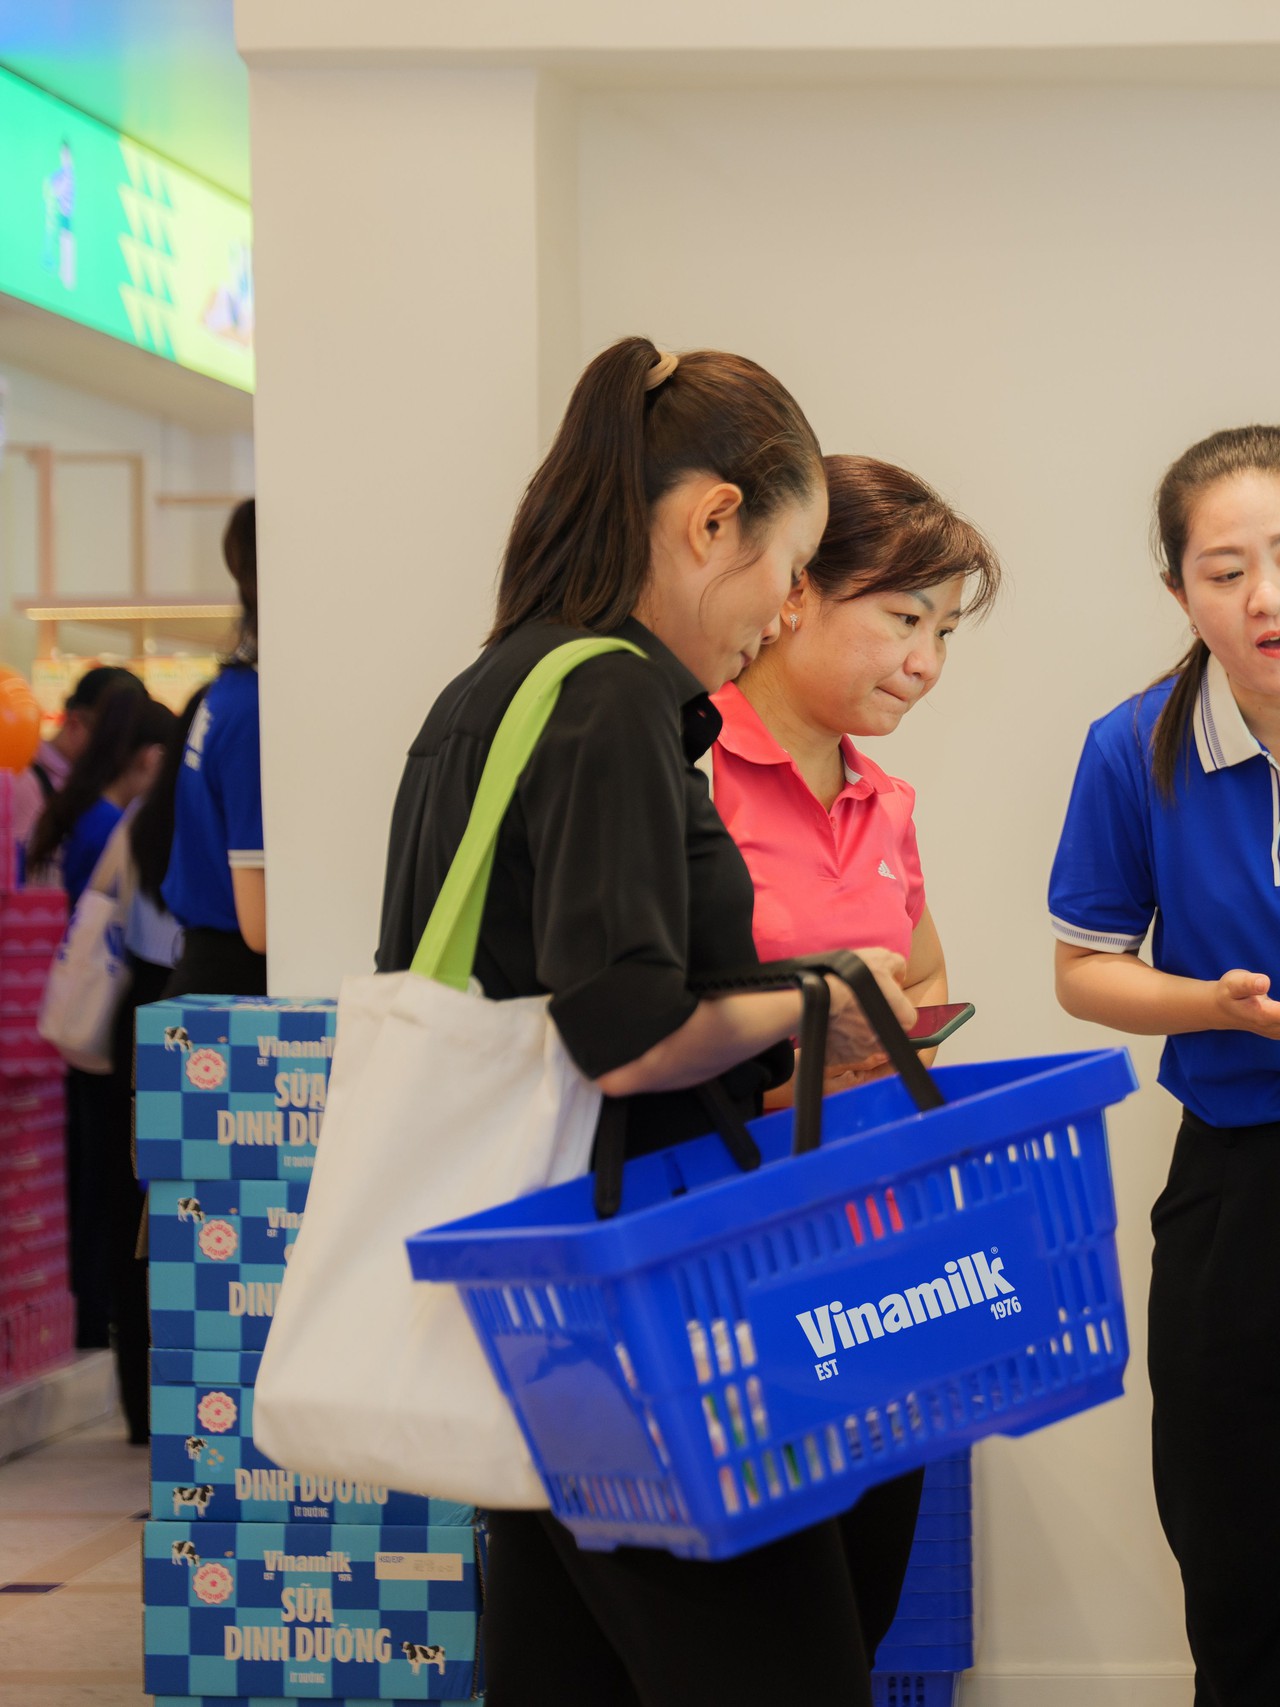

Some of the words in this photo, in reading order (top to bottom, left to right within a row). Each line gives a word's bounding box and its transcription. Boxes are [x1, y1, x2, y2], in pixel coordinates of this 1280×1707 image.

[257, 1035, 335, 1058] Vinamil
[217, 1110, 284, 1146] DINH
[796, 1250, 1016, 1358] Vinamilk
[990, 1296, 1022, 1320] 1976
[814, 1358, 839, 1382] EST
[235, 1468, 295, 1502] DINH
[263, 1550, 352, 1573] Vinamilk
[280, 1582, 334, 1623] SỮA
[224, 1625, 290, 1662] DINH
[295, 1622, 392, 1664] DƯỠNG
